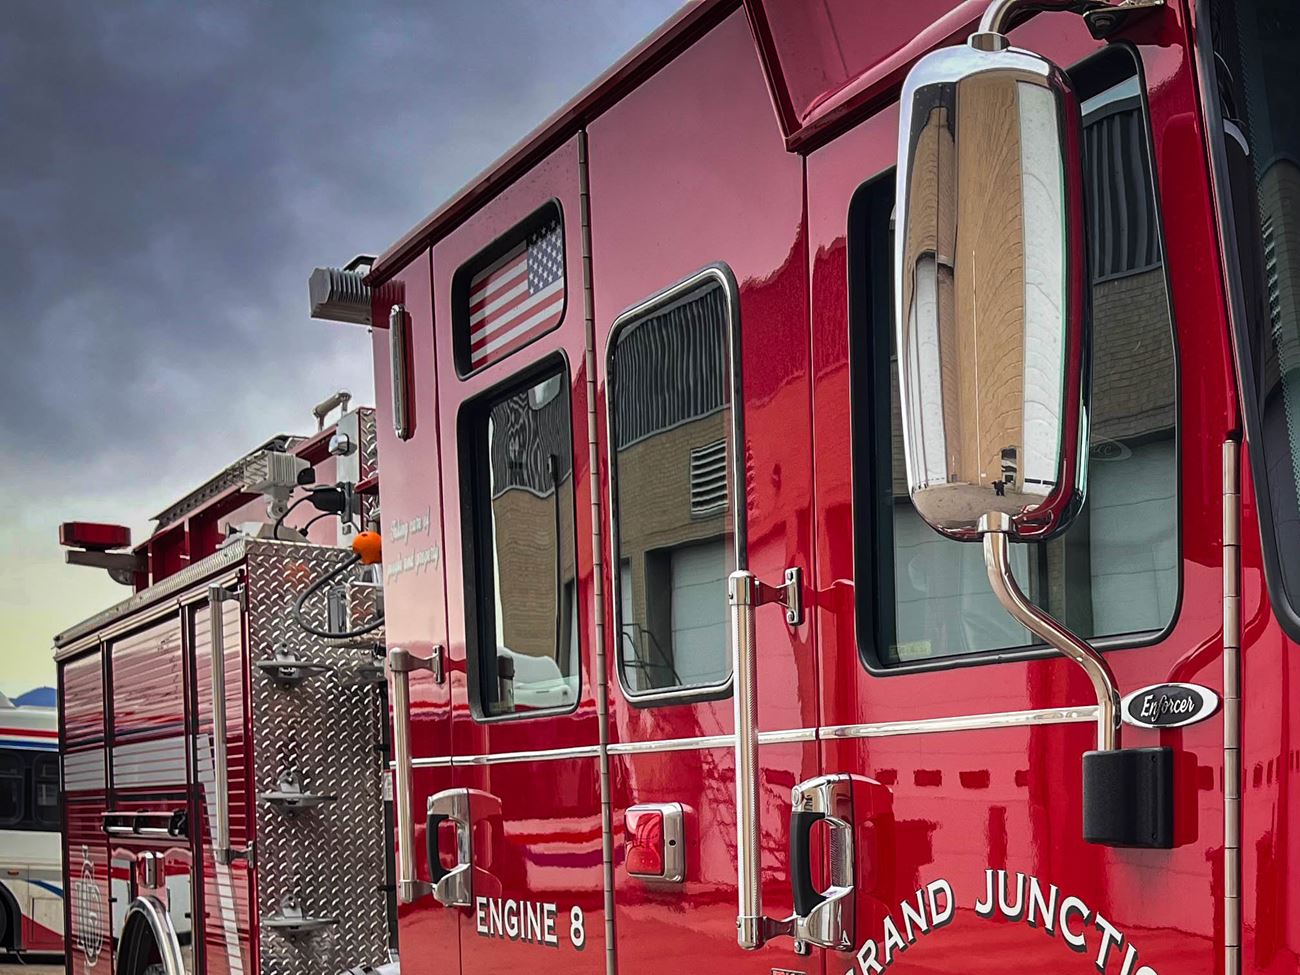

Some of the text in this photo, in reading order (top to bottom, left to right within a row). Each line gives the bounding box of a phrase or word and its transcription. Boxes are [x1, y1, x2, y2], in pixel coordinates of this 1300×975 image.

[1140, 694, 1195, 722] Enforcer
[475, 895, 586, 950] ENGINE 8
